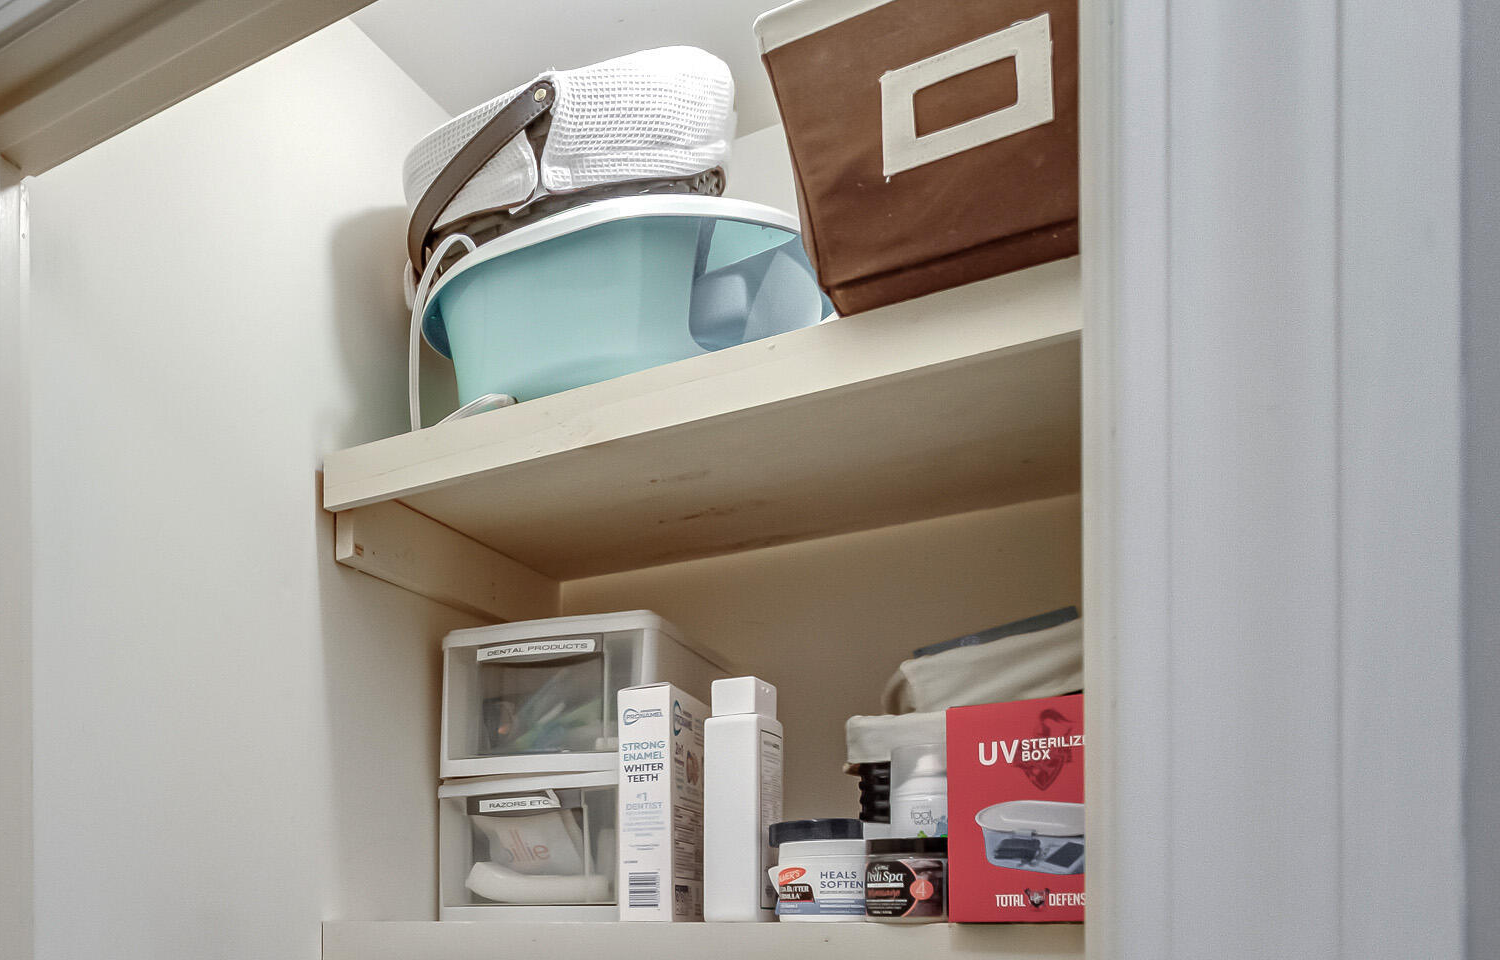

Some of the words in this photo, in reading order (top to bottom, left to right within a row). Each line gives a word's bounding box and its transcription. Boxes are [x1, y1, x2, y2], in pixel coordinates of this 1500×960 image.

[487, 647, 524, 657] DENTAL
[527, 642, 588, 652] PRODUCTS
[622, 740, 666, 751] STRONG
[623, 750, 665, 762] ENAMEL
[978, 739, 1019, 766] UV
[1021, 749, 1051, 762] BOX
[623, 762, 664, 773] WHITER
[627, 773, 659, 783] TEETH
[489, 800, 527, 809] RAZORS
[626, 802, 663, 811] DENTIST
[820, 871, 857, 879] HEALS
[882, 870, 904, 883] Spa
[915, 880, 927, 898] 4
[995, 893, 1026, 907] TOTAL
